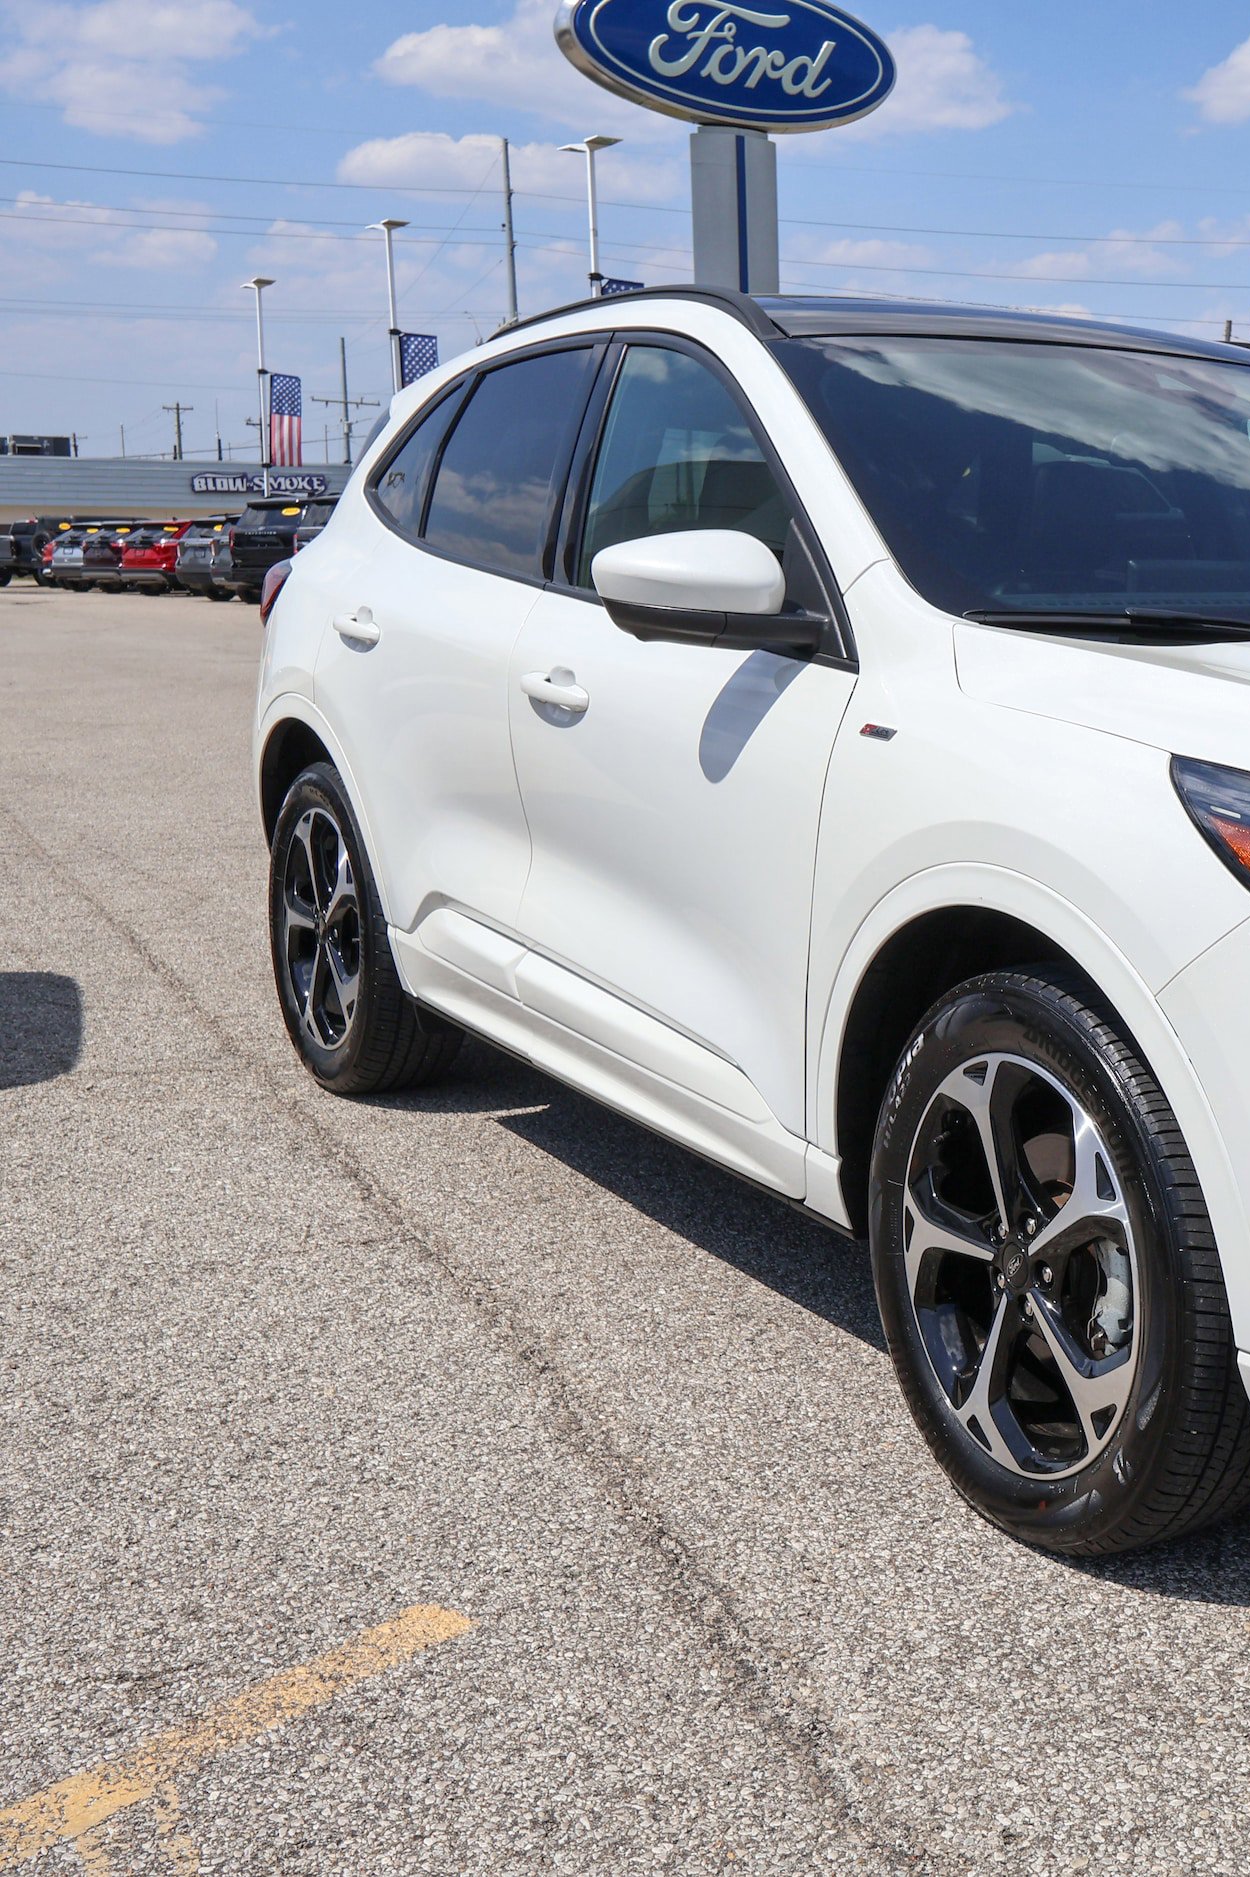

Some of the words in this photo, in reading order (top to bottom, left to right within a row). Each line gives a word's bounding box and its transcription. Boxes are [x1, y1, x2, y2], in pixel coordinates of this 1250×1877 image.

[648, 0, 837, 98] Ford
[194, 474, 247, 491] BLOW
[252, 476, 326, 494] SMOKE
